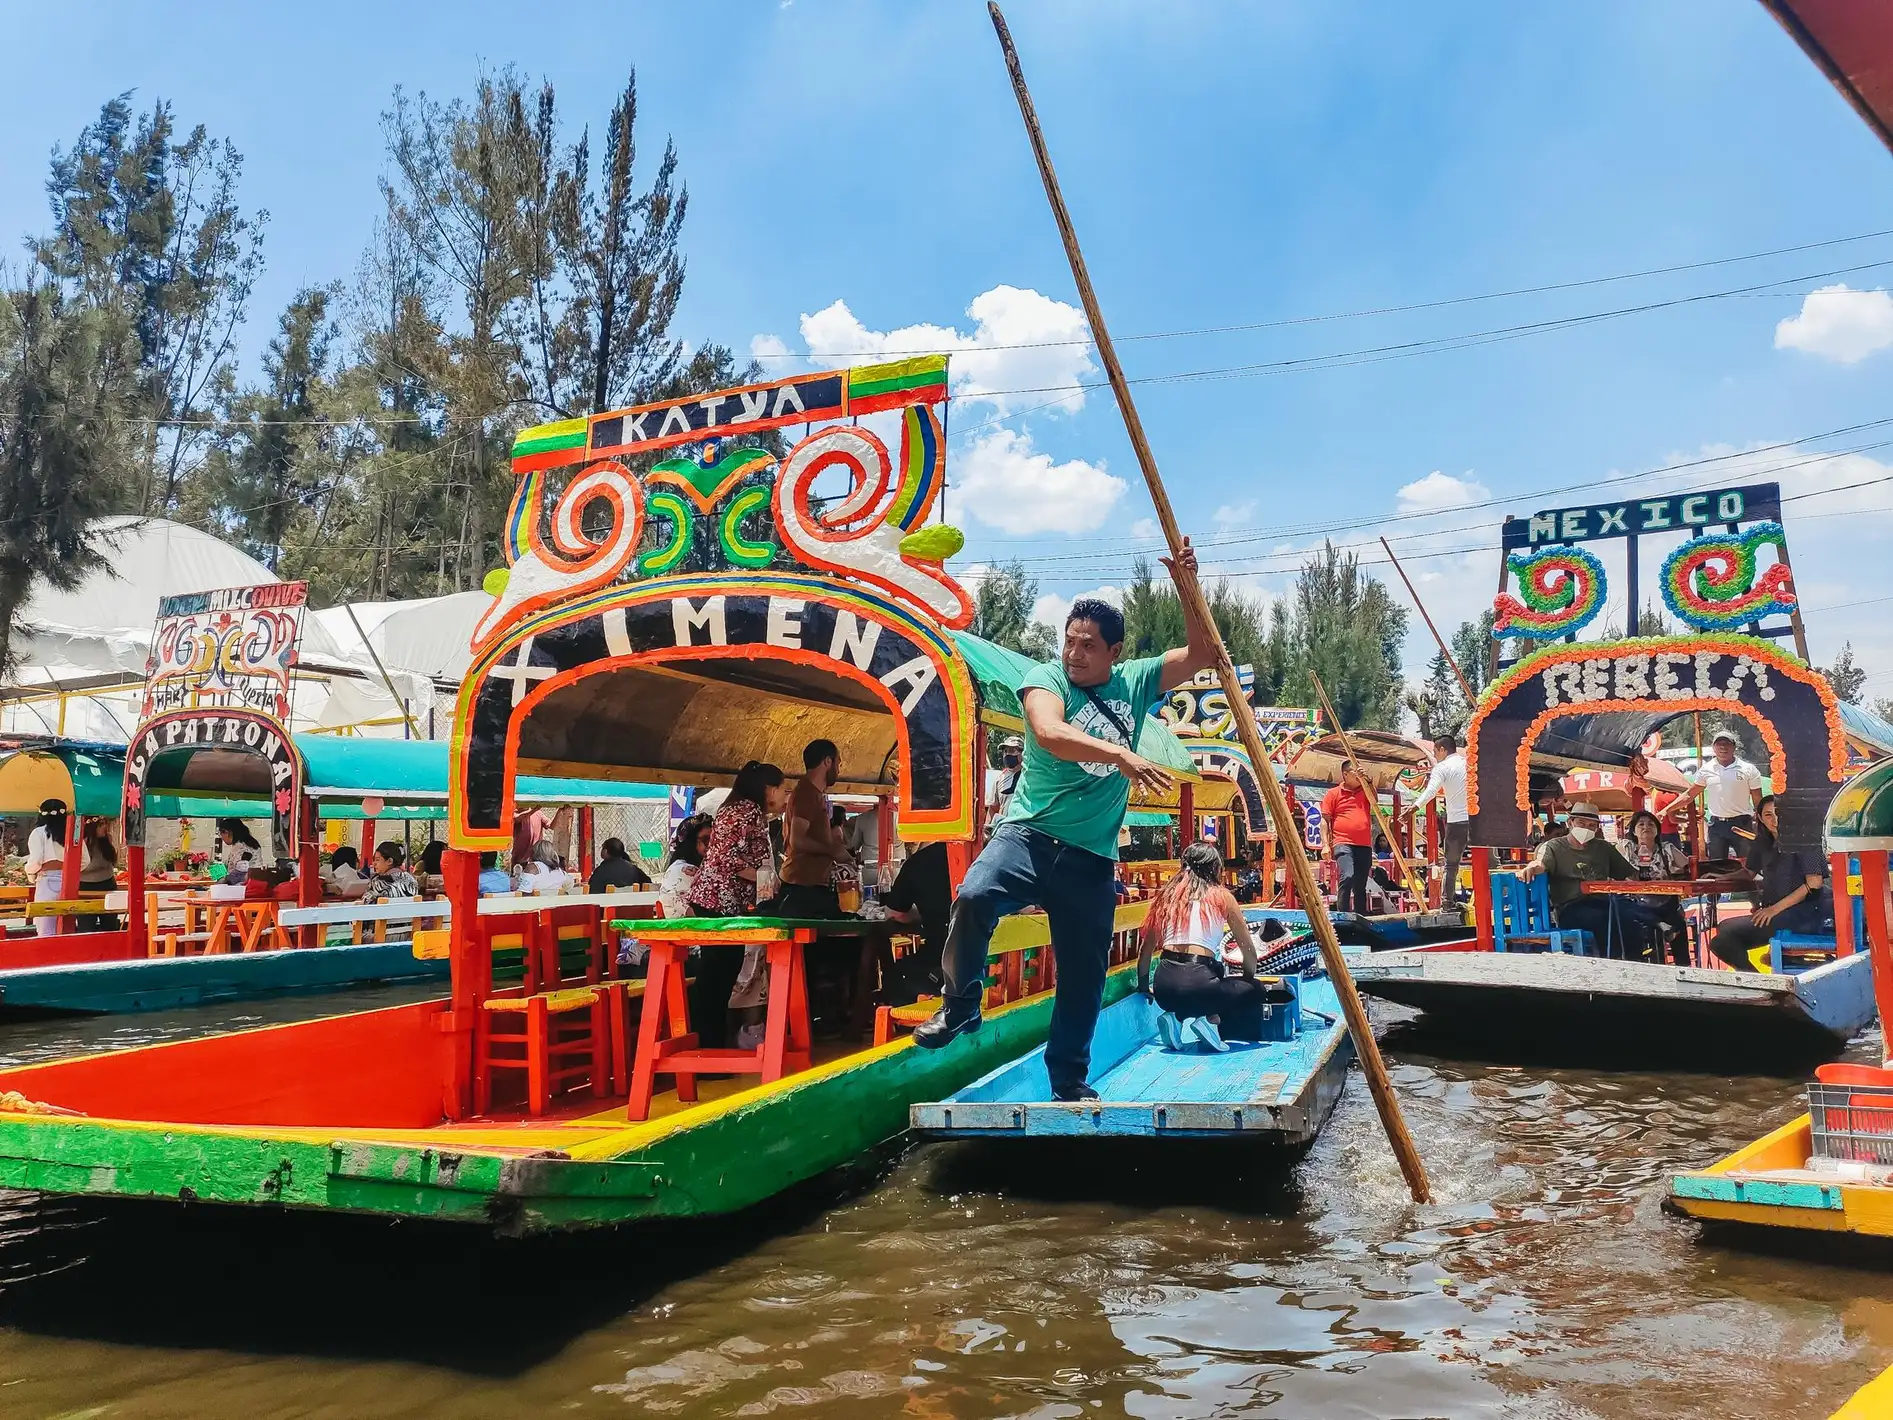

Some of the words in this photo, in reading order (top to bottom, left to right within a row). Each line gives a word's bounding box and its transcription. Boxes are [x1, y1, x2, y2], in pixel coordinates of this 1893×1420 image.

[621, 384, 805, 445] KATYA
[1529, 492, 1744, 543] MEXICO
[488, 595, 938, 717] XIMENA
[166, 717, 293, 786] PATRONA
